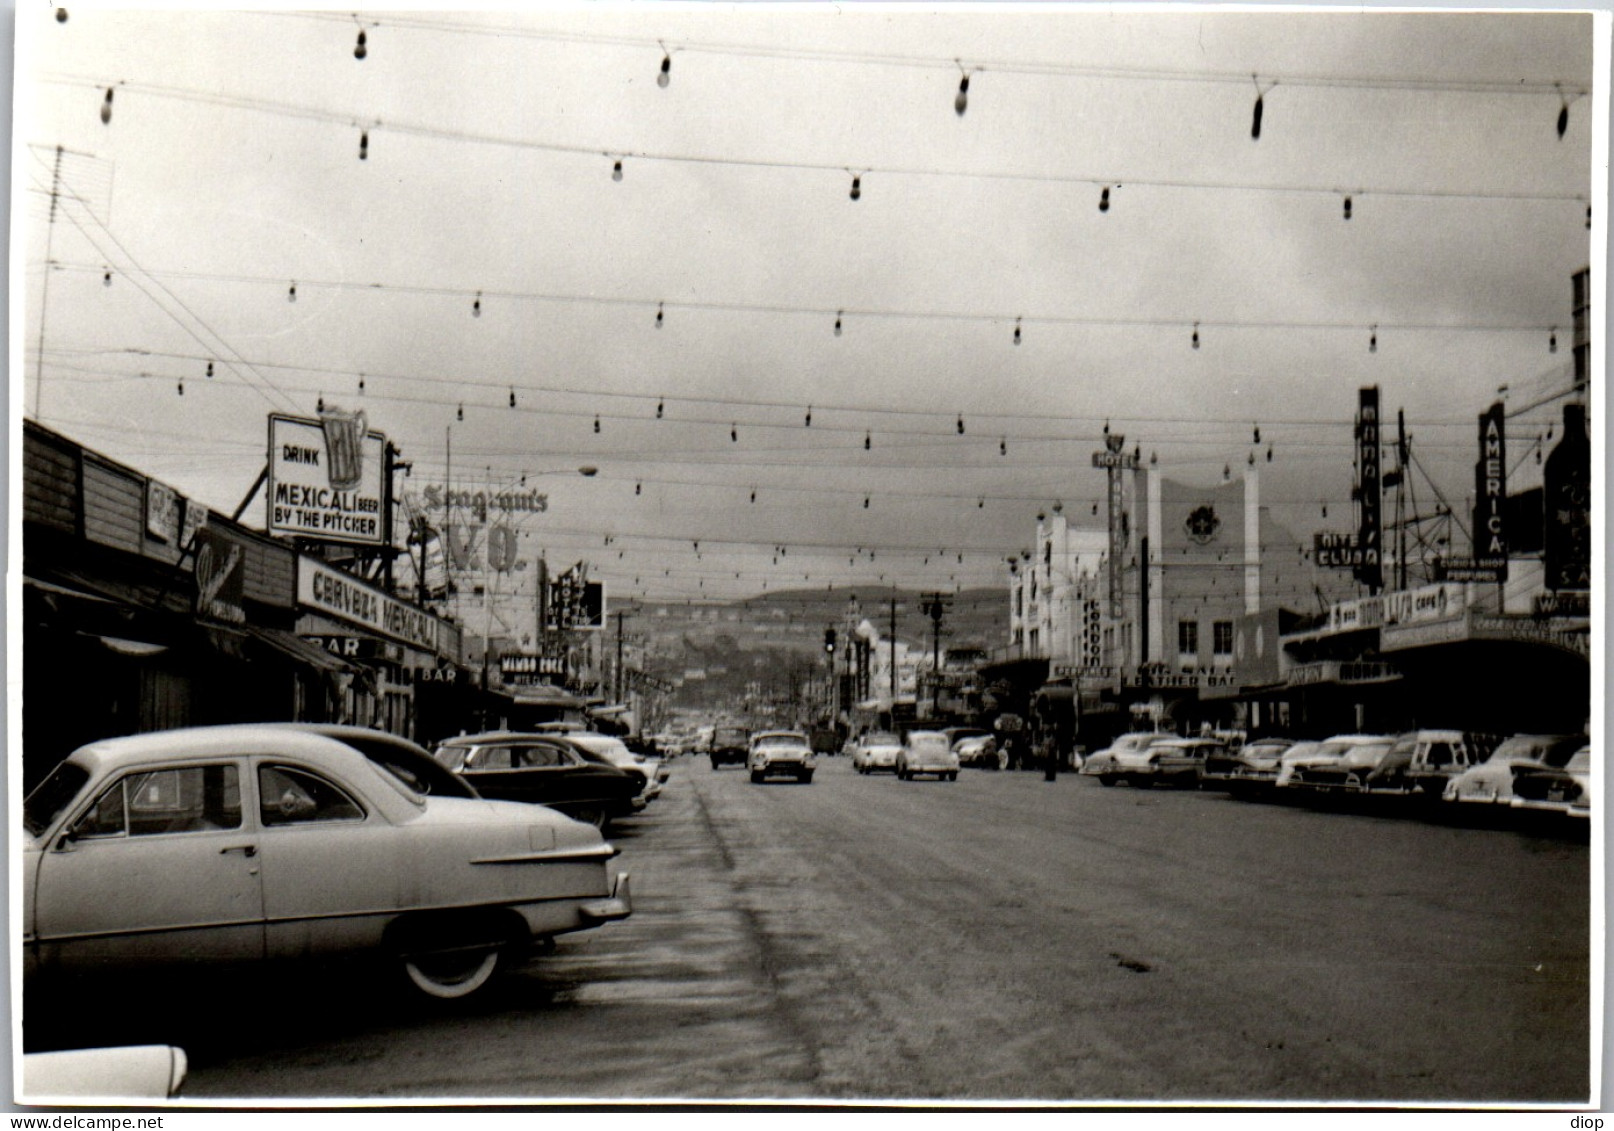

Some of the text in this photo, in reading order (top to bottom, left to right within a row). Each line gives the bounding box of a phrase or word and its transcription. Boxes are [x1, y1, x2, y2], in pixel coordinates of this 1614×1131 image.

[283, 444, 319, 466] DRINK
[275, 483, 379, 513] MEXICALI BEER
[1485, 419, 1503, 554] AMERICA
[274, 507, 376, 536] BY THE PITCHER
[1479, 558, 1505, 568] SHOP
[313, 570, 436, 651] CERVEZA MEXICALI
[561, 577, 571, 630] MOTEL
[422, 669, 457, 681] BAR
[502, 656, 537, 672] MAMBO
